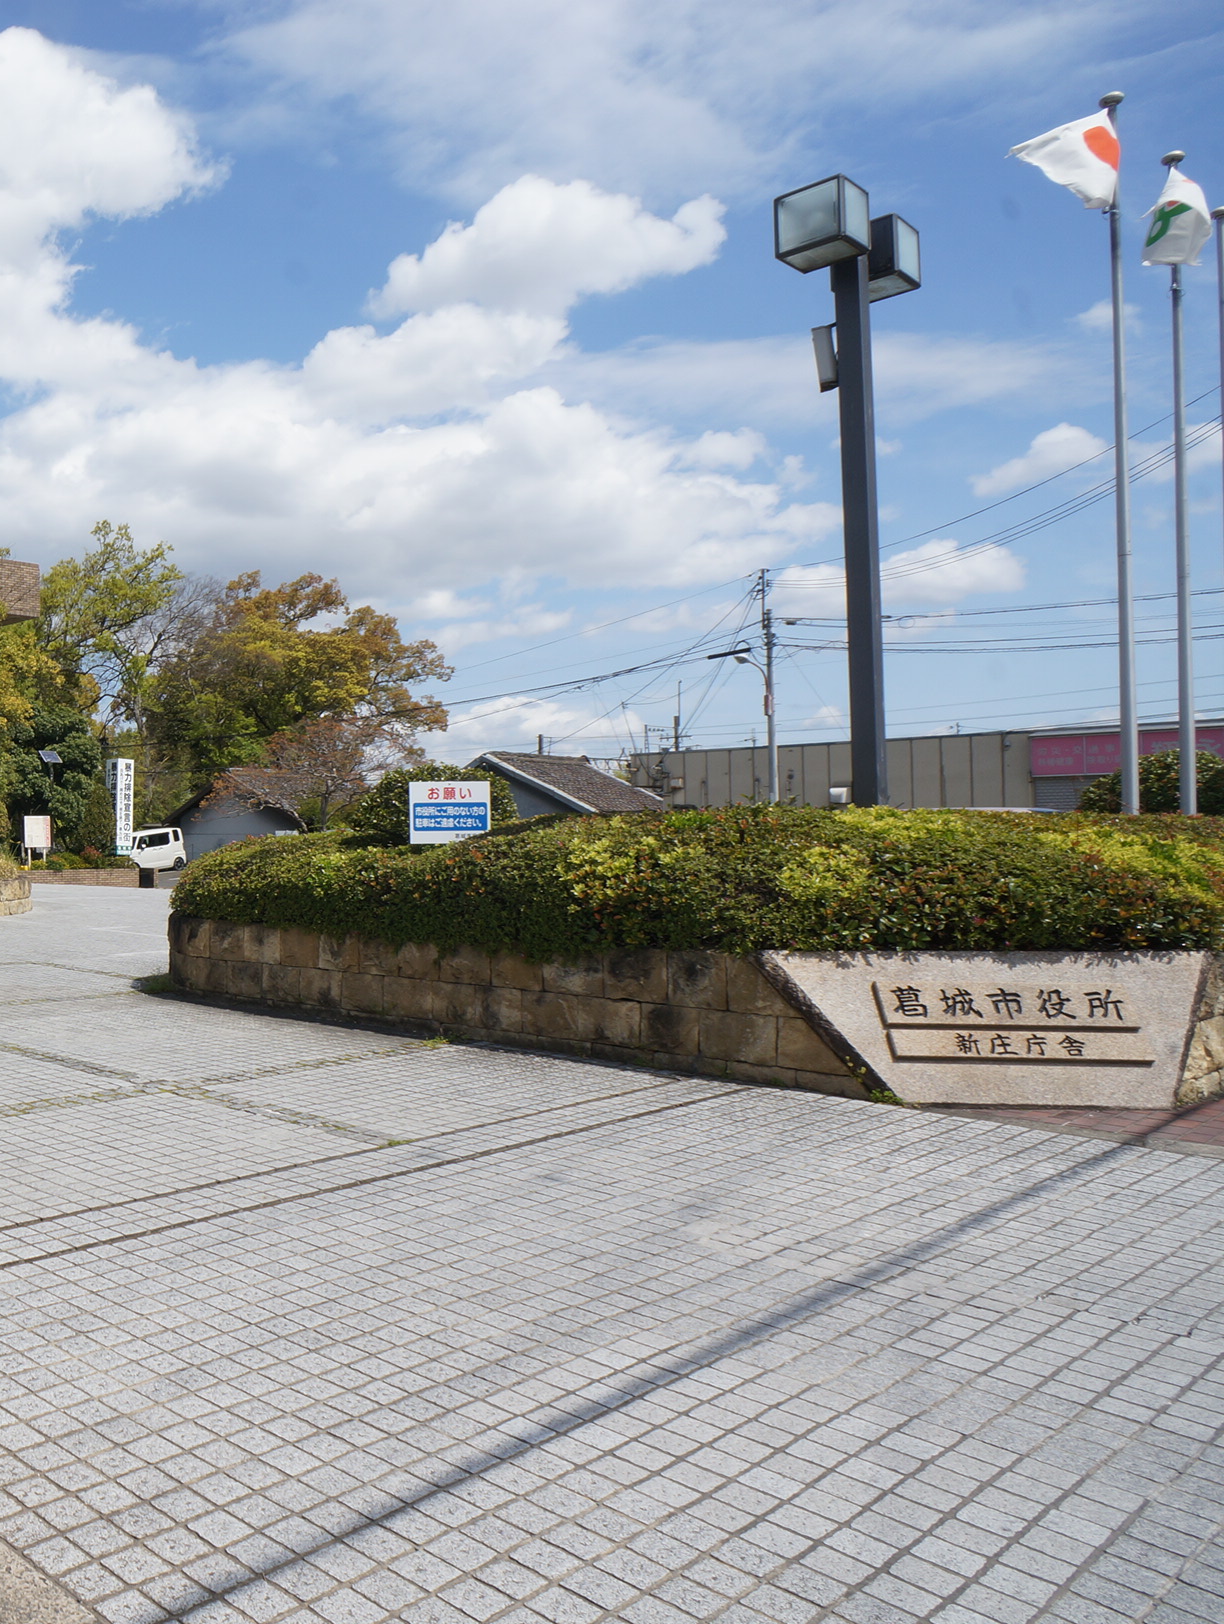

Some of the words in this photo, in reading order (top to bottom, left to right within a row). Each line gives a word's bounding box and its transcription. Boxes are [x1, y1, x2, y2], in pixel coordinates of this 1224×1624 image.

[427, 786, 472, 800] お願い
[415, 806, 486, 816] 市役所にご用のない方の
[415, 817, 482, 828] 駐車はご遠慮ください。
[889, 985, 1125, 1022] 葛城市役所
[954, 1031, 1087, 1058] 新庄庁舎
